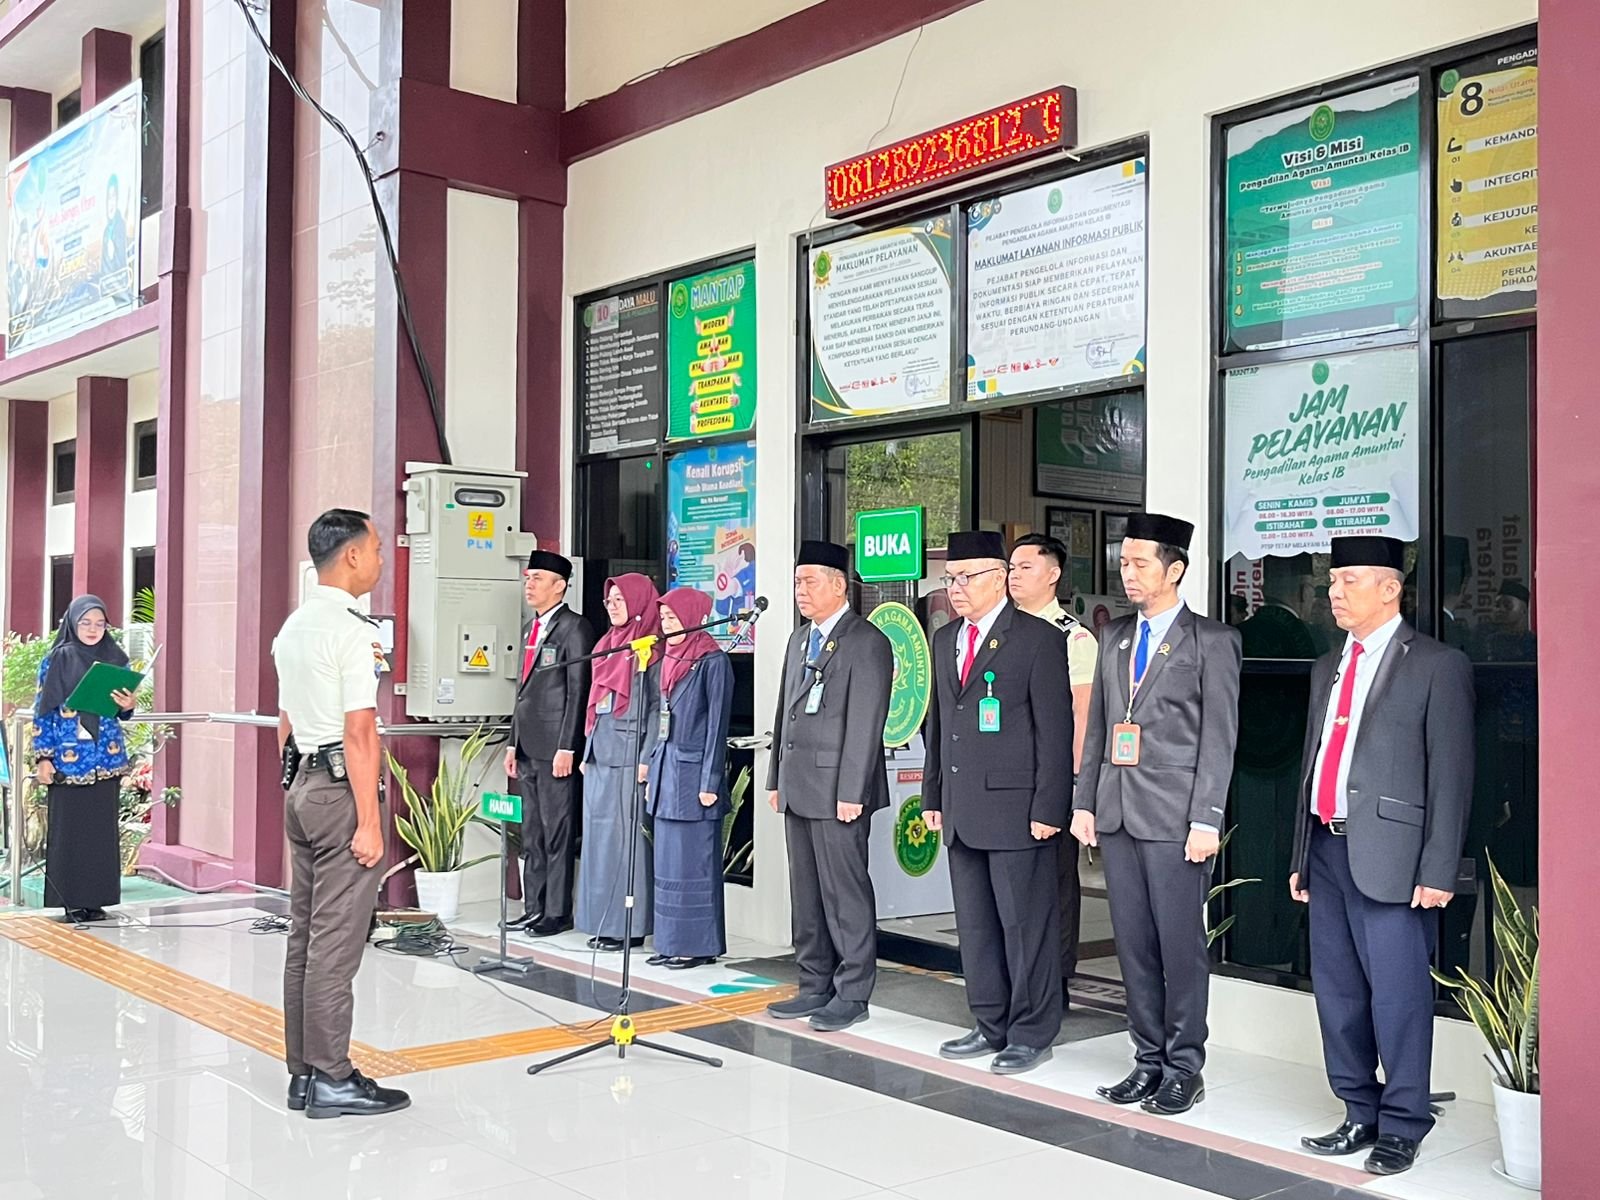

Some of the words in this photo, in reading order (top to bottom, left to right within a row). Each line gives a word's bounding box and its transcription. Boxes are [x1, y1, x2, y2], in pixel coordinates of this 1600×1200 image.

[1460, 82, 1484, 116] 8
[1284, 148, 1312, 166] Visi
[1316, 144, 1325, 158] &
[1330, 136, 1361, 155] Misi
[1240, 172, 1289, 191] Pengadilan
[1292, 164, 1323, 179] Agama
[1326, 154, 1367, 170] Amuntai
[1369, 146, 1396, 160] Kelas
[1399, 143, 1409, 154] IB
[1312, 178, 1329, 189] Visi
[1312, 217, 1332, 228] Misi
[974, 250, 1018, 270] MAKLUMAT
[1020, 240, 1060, 258] LAYANAN
[1062, 228, 1110, 248] INFORMASI
[1112, 219, 1142, 237] PUBLIK
[836, 256, 873, 274] MAKLUMAT
[876, 243, 918, 262] PELAYANAN
[1236, 251, 1241, 262] 1
[986, 271, 1017, 285] PEJABAT
[1020, 261, 1063, 277] PENGELOLA
[1066, 251, 1108, 267] INFORMASI
[1110, 247, 1127, 258] DAN
[1235, 265, 1242, 276] 2
[972, 281, 1022, 299] DOKUMENTASI
[1024, 277, 1041, 288] SIAP
[1043, 266, 1093, 284] MEMBERIKAN
[1095, 255, 1143, 273] PELAYANAN
[691, 274, 744, 309] MANTAP
[979, 294, 1017, 308] INFORMASI
[1019, 288, 1045, 300] PUBLIK
[1047, 281, 1077, 294] SECARA
[1110, 269, 1134, 281] TEPAT
[1004, 300, 1040, 314] BERBIAYA
[1042, 294, 1070, 307] RINGAN
[1072, 290, 1088, 300] DAN
[1091, 280, 1139, 297] SEDERHANA
[636, 290, 656, 306] MALU
[980, 319, 1005, 331] SESUAI
[1007, 313, 1037, 325] DENGAN
[1039, 303, 1083, 319] KETENTUAN
[1086, 293, 1134, 310] PERATURAN
[1234, 304, 1243, 316] 4
[702, 318, 725, 329] MODERN
[698, 376, 730, 388] TRANSPARAN
[699, 395, 728, 407] AKUNTABEL
[1289, 384, 1349, 423] JAM
[696, 414, 730, 427] PROFESIONAL
[1248, 402, 1407, 463] PELAYANAN
[1243, 457, 1306, 480] Pengadilan
[1308, 450, 1349, 470] Agama
[1352, 433, 1406, 458] Amuntai
[686, 465, 710, 478] Kenali
[1298, 467, 1330, 486] Kelas
[1332, 466, 1345, 478] IB
[1258, 500, 1280, 510] SENIN
[1288, 498, 1314, 507] KAMIS
[1339, 495, 1370, 505] JUM'AT
[1297, 509, 1312, 517] WITA
[1335, 515, 1376, 526] ISTIRAHAT
[1266, 520, 1304, 530] ISTIRAHAT
[467, 540, 493, 550] PLN
[864, 532, 911, 557] BUKA
[884, 610, 913, 634] AGAMA
[910, 634, 924, 688] AMUNTAI
